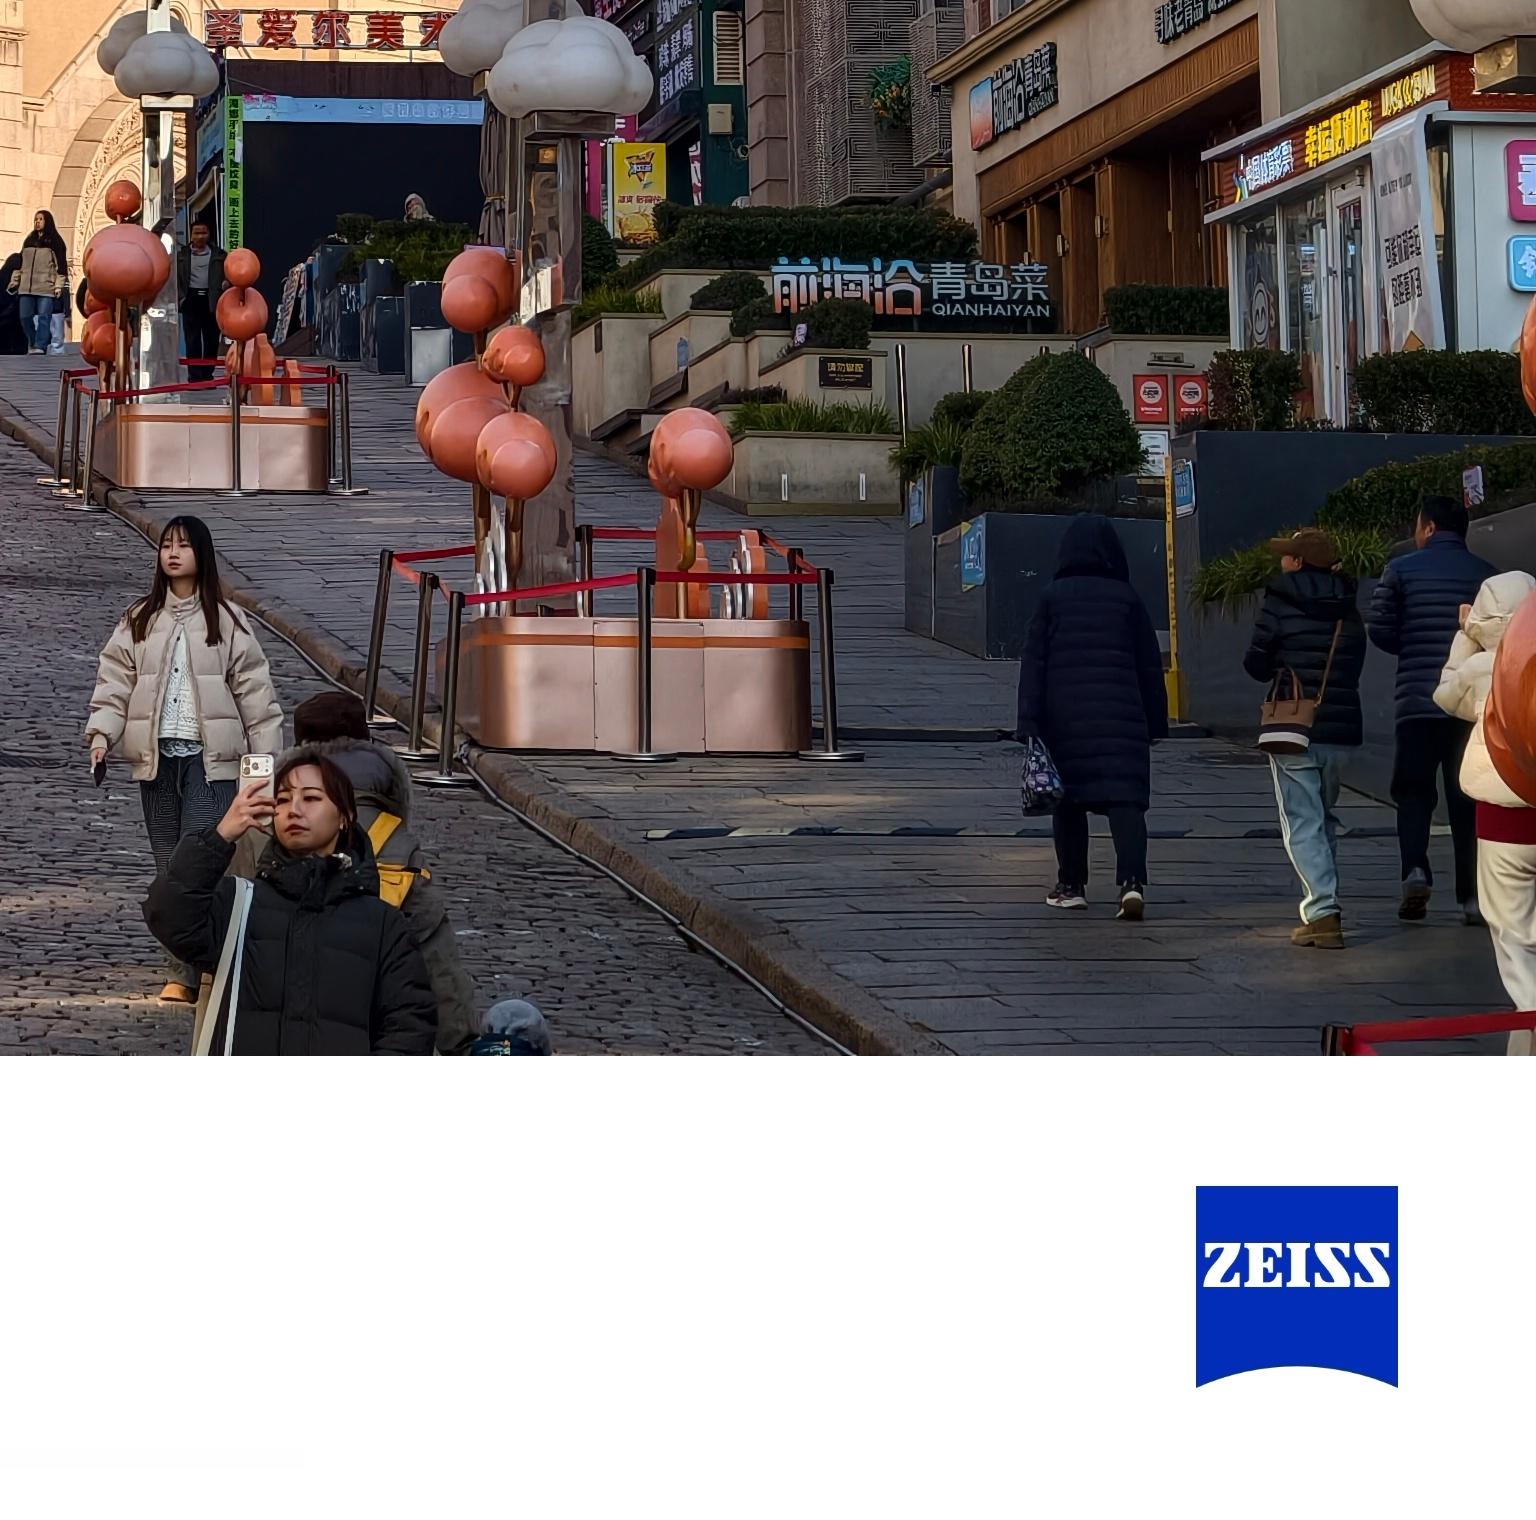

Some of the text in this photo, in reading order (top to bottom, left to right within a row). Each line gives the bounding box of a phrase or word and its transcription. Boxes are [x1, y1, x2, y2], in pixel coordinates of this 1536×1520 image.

[771, 257, 1050, 315] 前海沿 青岛菜
[932, 303, 1050, 318] QIANHAIYAN
